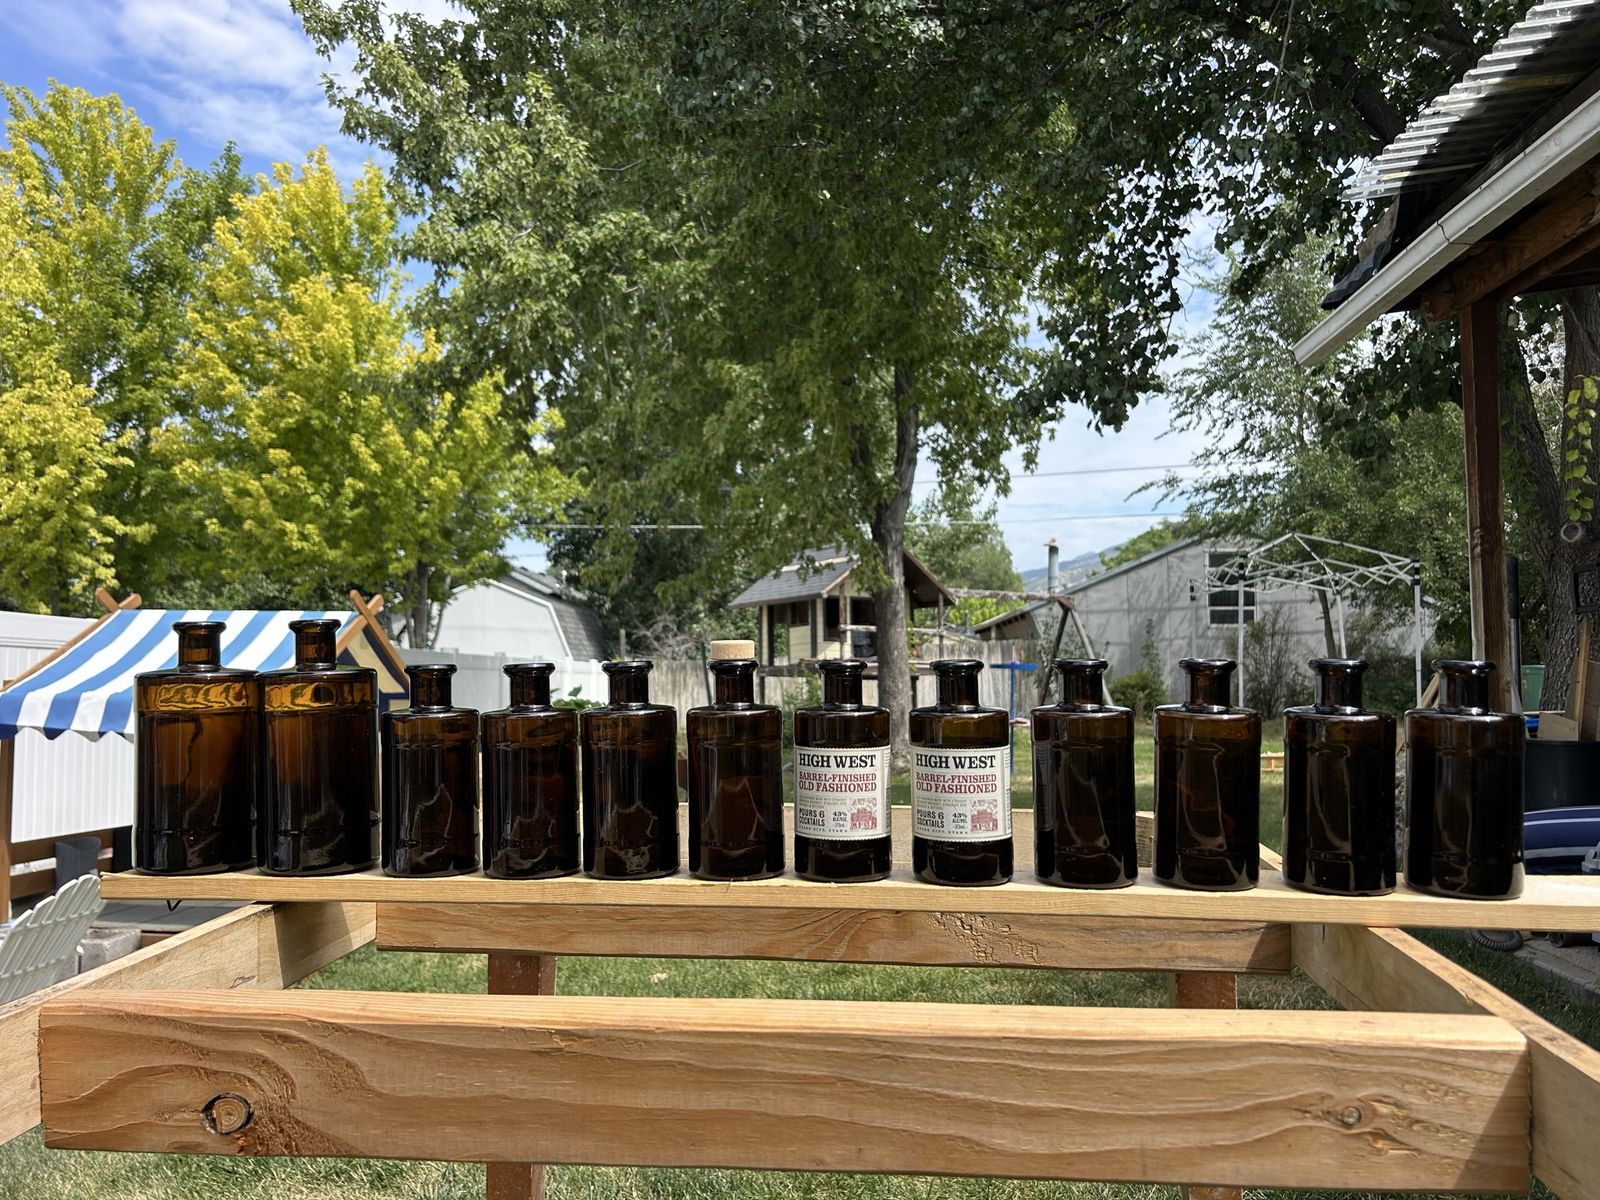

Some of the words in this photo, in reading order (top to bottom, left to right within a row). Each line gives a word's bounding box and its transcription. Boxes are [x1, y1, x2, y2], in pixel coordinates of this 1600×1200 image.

[799, 753, 831, 768] HIGH
[833, 754, 876, 768] WEST
[916, 753, 950, 769] HIGH
[952, 755, 995, 769] WEST
[799, 771, 877, 783] BARREL-FINISHED
[916, 772, 997, 783] BARREL-FINISHED
[799, 780, 814, 791] OLD
[816, 782, 877, 793] FASHIONED
[916, 781, 932, 792] OLD
[934, 783, 997, 794] FASHIONED
[799, 808, 817, 818] POURS
[917, 809, 936, 819] POURS
[938, 812, 944, 820] 6
[799, 816, 825, 827] COCKTAILS
[917, 817, 945, 829] COCKTAILS
